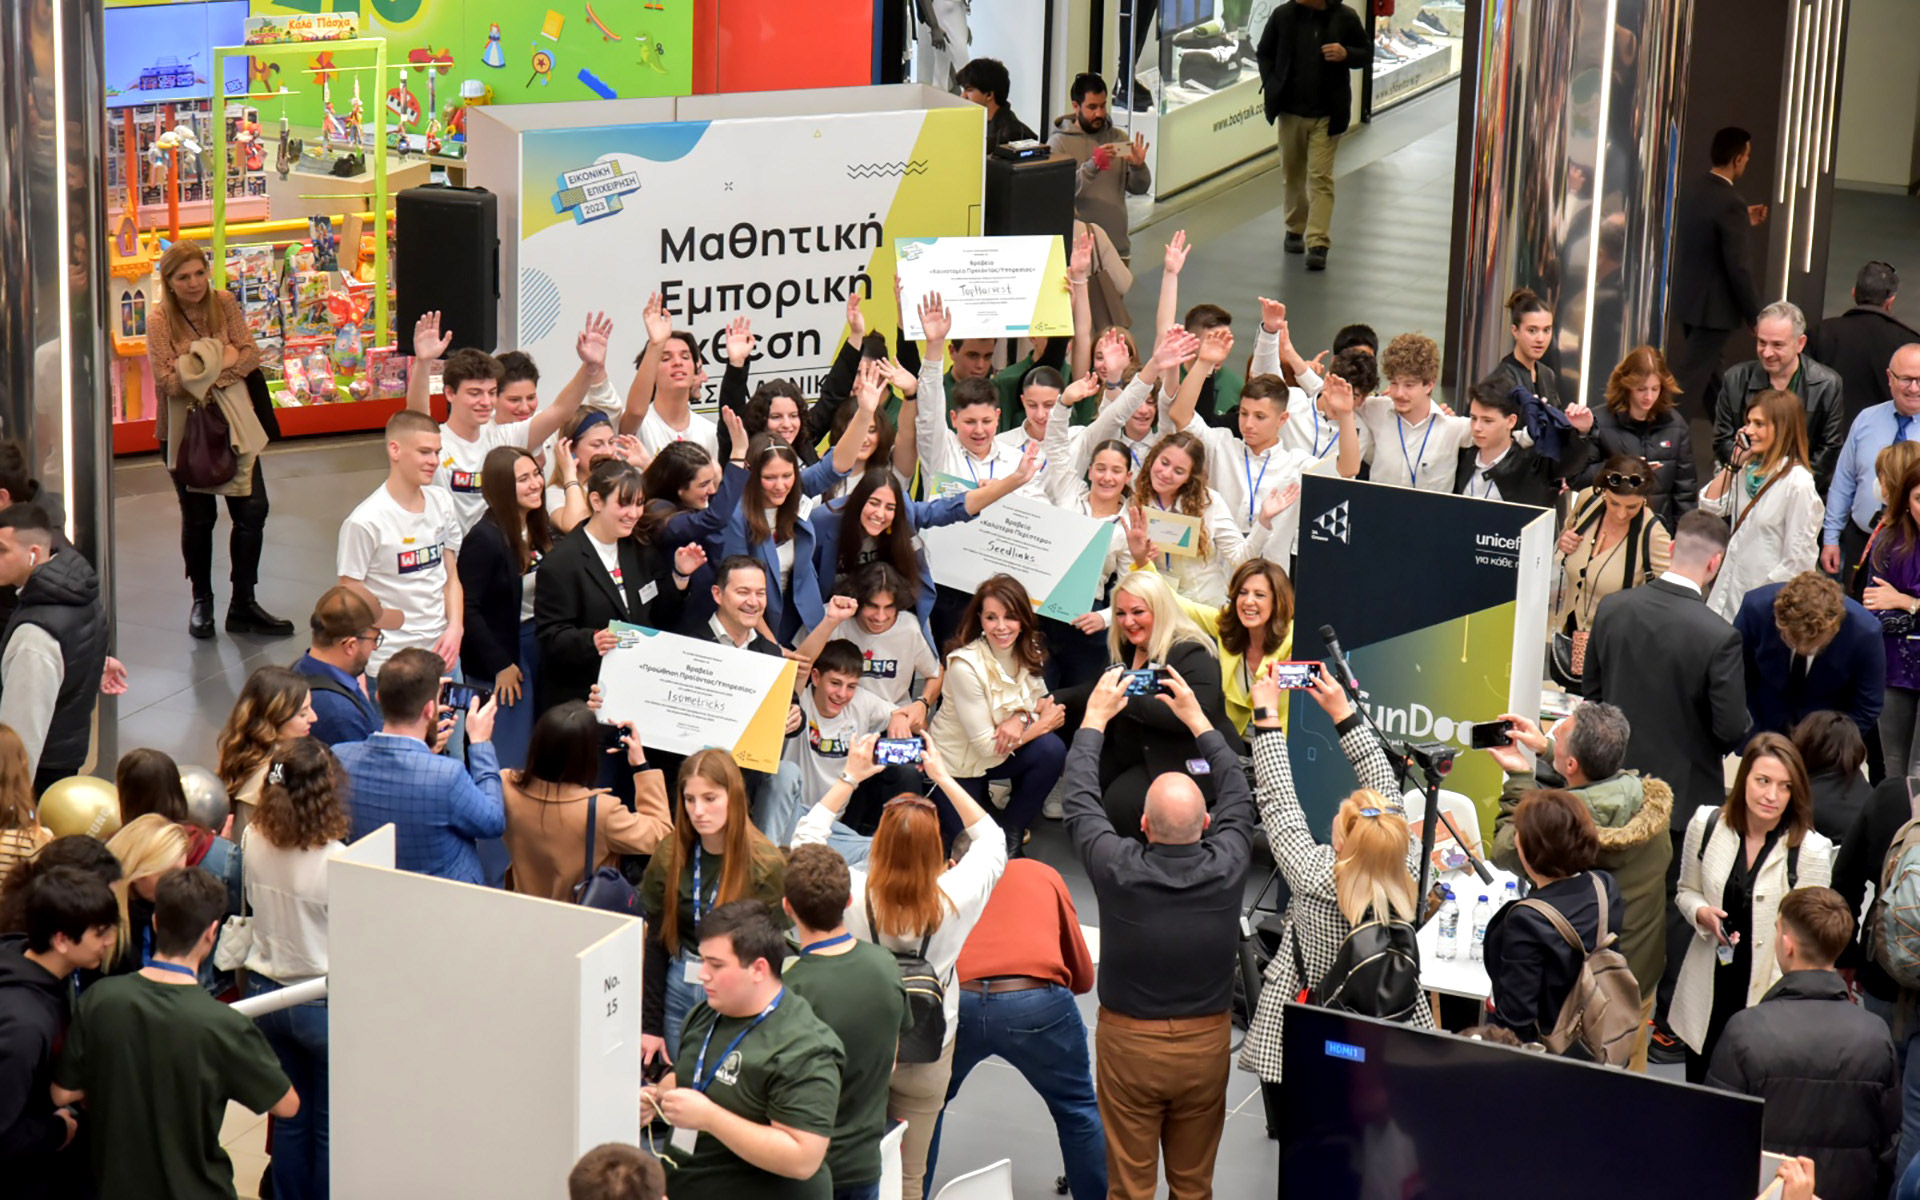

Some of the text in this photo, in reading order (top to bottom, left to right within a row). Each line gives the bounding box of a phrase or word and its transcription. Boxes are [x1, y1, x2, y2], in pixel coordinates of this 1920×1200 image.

[1213, 103, 1266, 132] www.bodytalk.co
[568, 167, 611, 184] ΕΙΚΟΝΙΚΗ
[587, 177, 637, 196] ΕΠΙΧΕΙΡΗΣΗ
[584, 202, 606, 214] 2023
[661, 212, 883, 264] Μαθητική
[661, 265, 872, 325] Εμπορική
[1475, 532, 1521, 550] unicef
[987, 540, 1036, 563] Seedlinks
[1475, 555, 1489, 565] για
[1490, 556, 1514, 568] κάθε
[667, 690, 726, 711] Isometricks
[604, 976, 620, 993] No.
[606, 997, 618, 1018] 15
